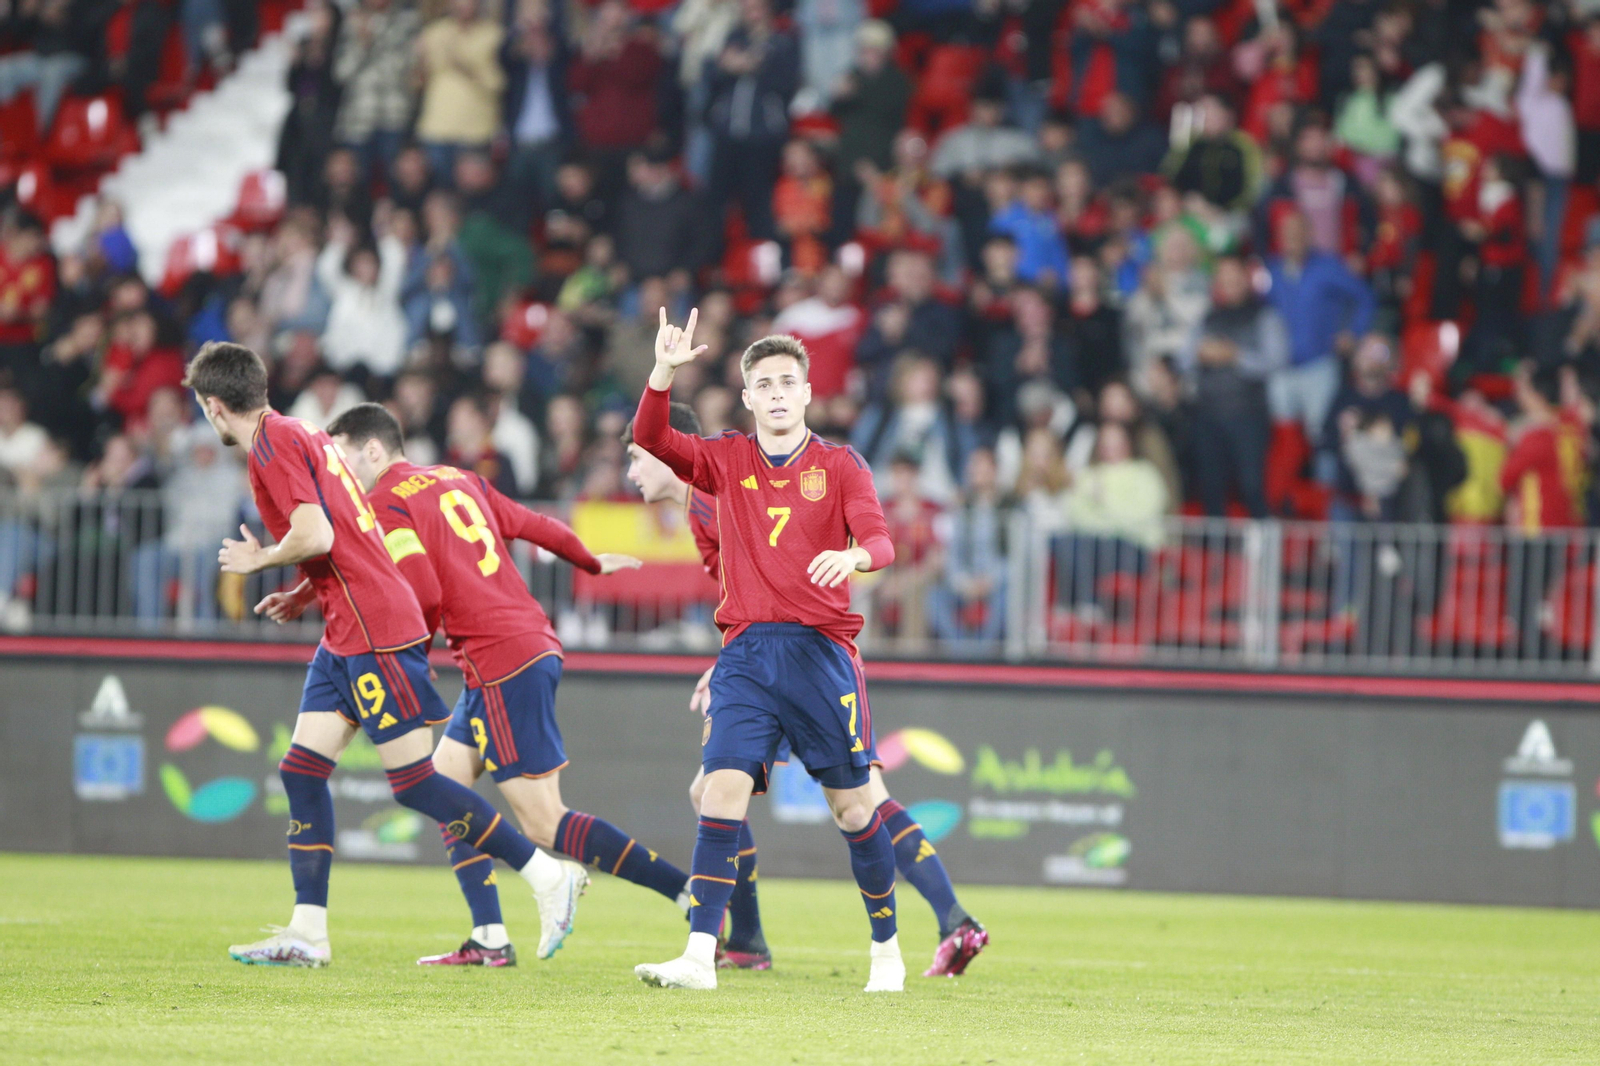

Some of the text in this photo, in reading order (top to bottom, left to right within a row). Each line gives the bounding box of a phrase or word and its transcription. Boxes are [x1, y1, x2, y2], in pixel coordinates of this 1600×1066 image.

[323, 443, 376, 533] 1
[391, 474, 436, 499] ABEL
[439, 489, 500, 577] 9
[767, 507, 791, 546] 7
[840, 692, 856, 736] 7
